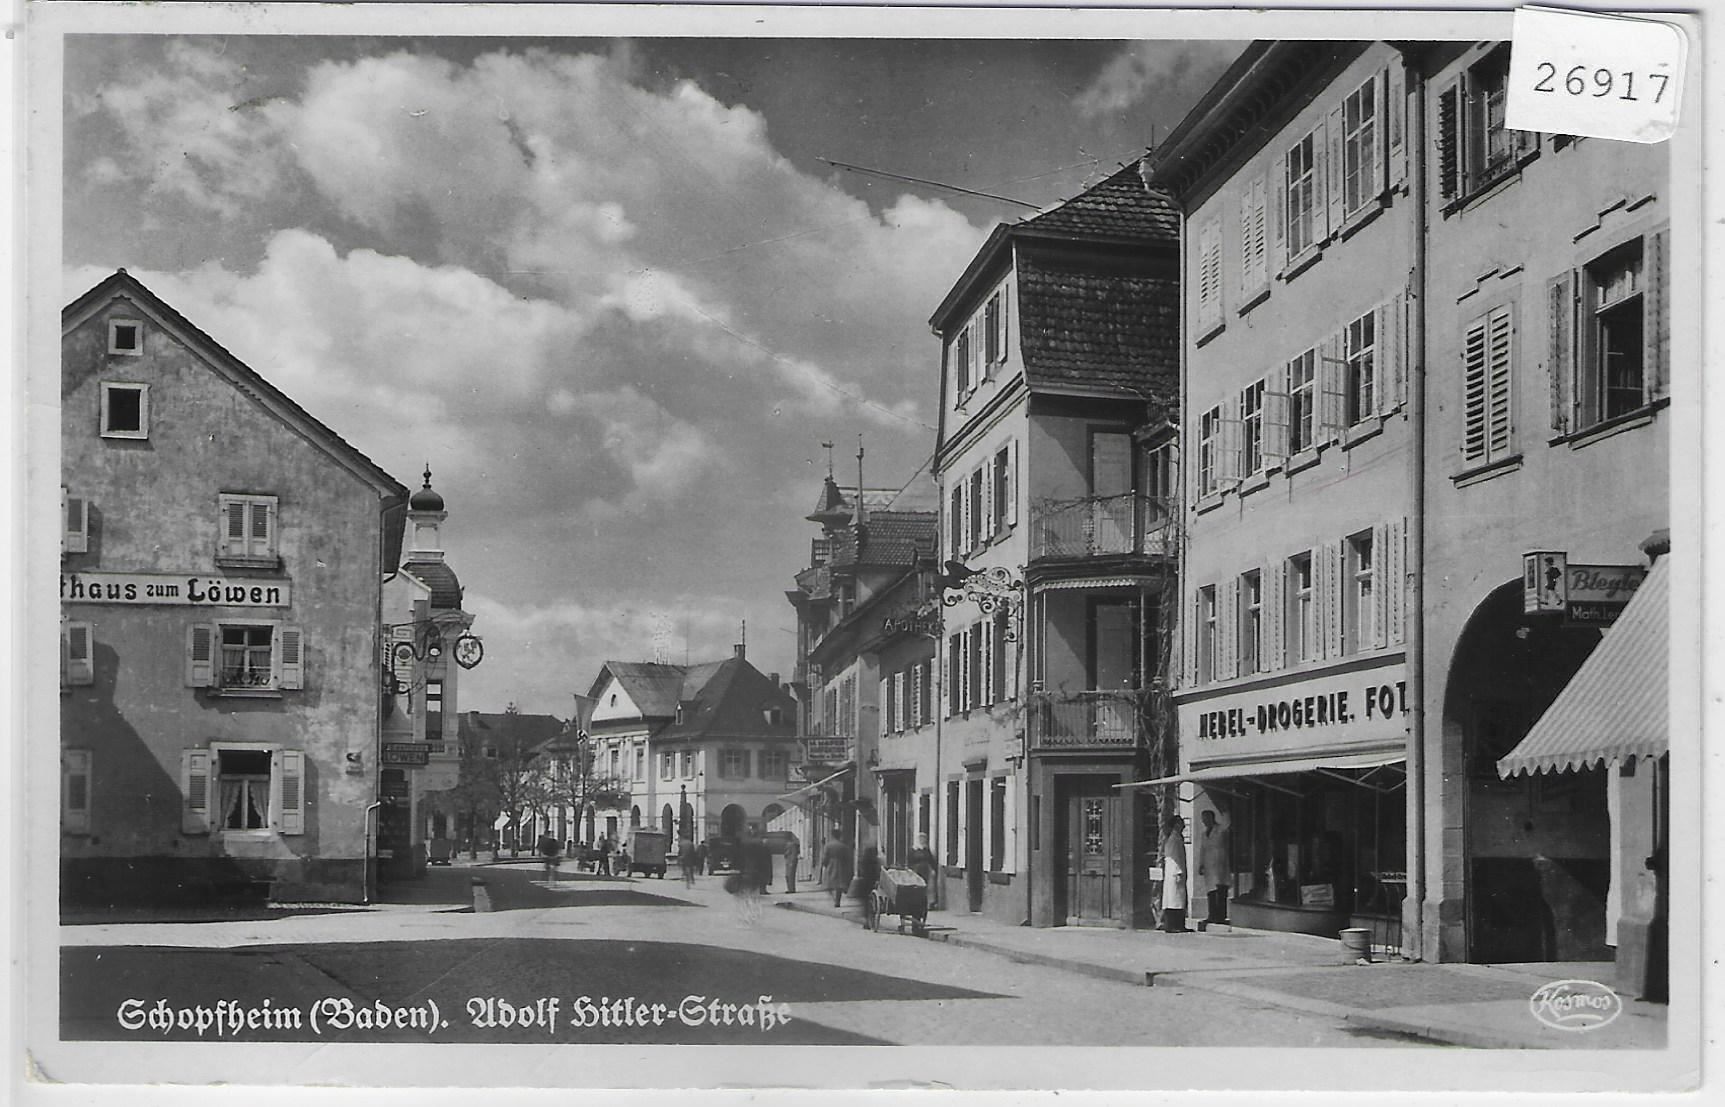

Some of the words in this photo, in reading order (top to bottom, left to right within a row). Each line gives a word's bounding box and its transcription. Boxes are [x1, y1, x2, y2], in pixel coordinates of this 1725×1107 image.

[1533, 62, 1669, 103] 26917
[147, 584, 179, 597] zum
[187, 578, 280, 603] Löwen
